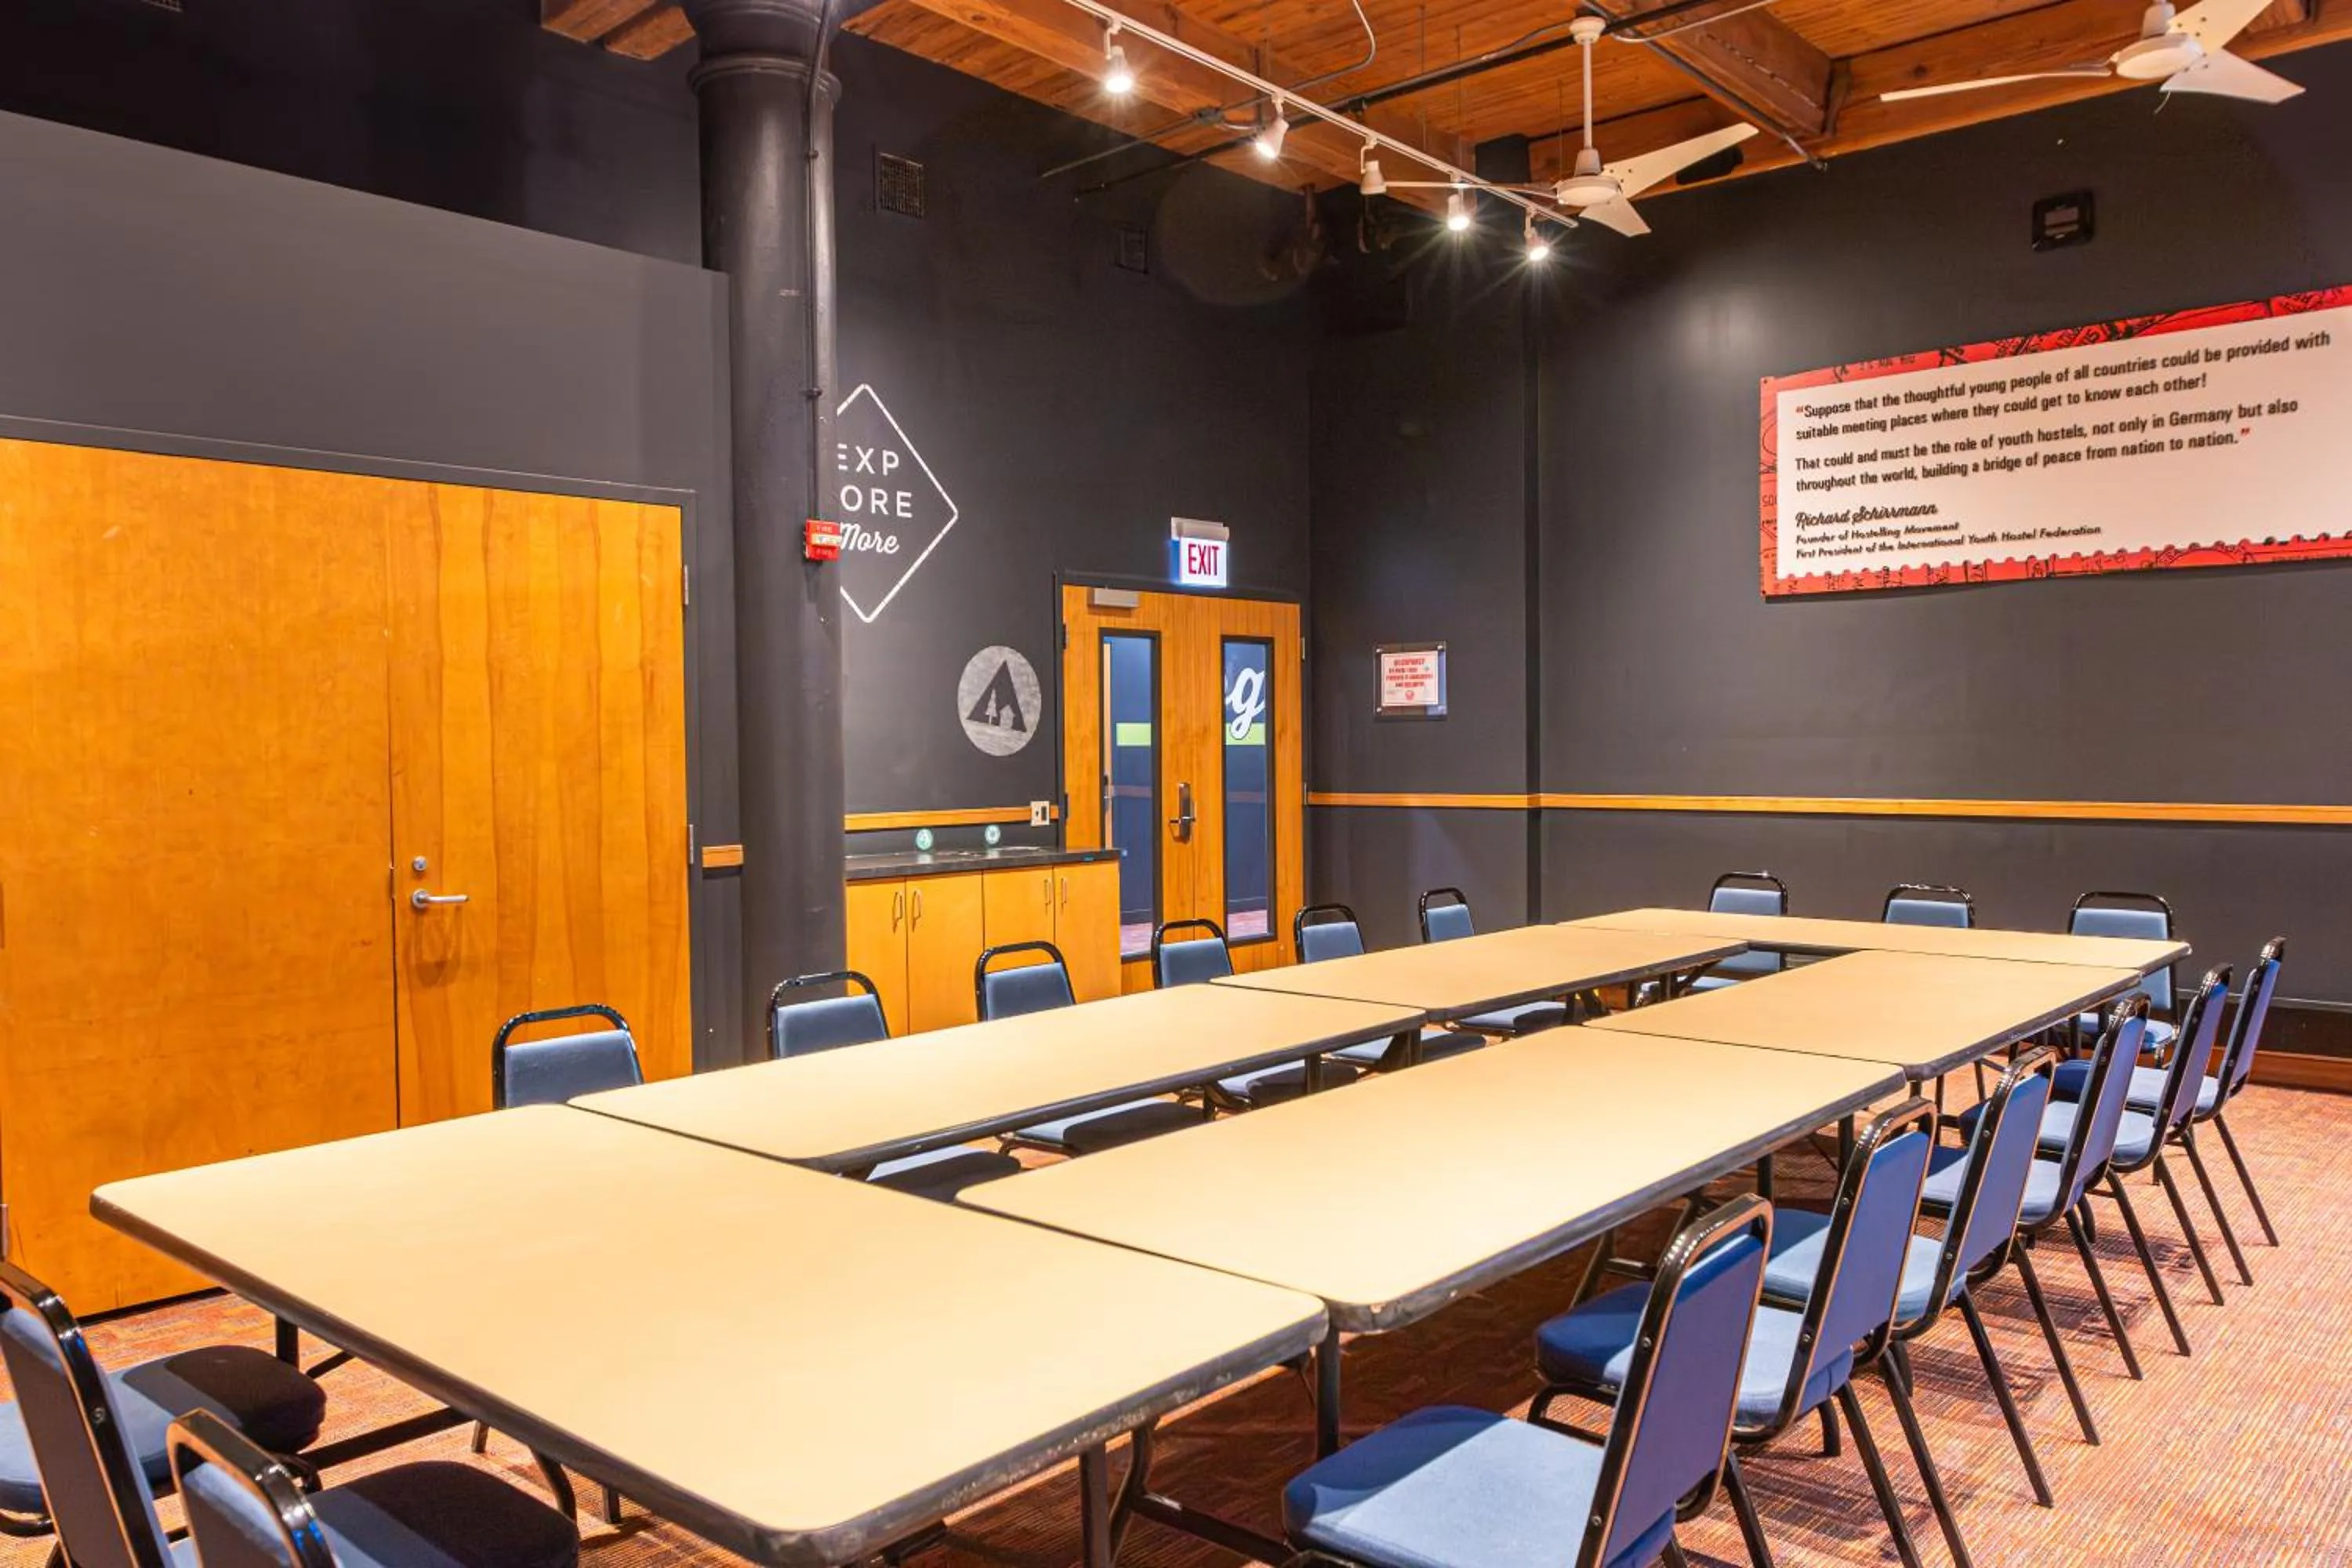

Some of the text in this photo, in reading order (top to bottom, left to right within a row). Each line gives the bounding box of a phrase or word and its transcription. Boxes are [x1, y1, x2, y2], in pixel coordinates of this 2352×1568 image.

[1855, 397, 1878, 411] that
[1882, 394, 1900, 407] the
[1904, 383, 1965, 404] thoughtful
[1969, 381, 2006, 397] young
[2010, 372, 2052, 390] people
[2056, 368, 2070, 382] of
[2074, 365, 2089, 380] all
[2093, 357, 2157, 377] countries
[2161, 349, 2199, 368] could
[2204, 347, 2221, 362] be
[2227, 336, 2290, 362] provided
[2296, 330, 2331, 350] with
[1796, 372, 2207, 440] suitable meeting places where they could get to know each other!
[1795, 398, 2298, 470] That could and must be the role of youth hostels, not only in Germany but also
[1796, 474, 1856, 492] throughout
[1860, 472, 1878, 485] the
[1882, 466, 1918, 482] world,
[1922, 463, 1969, 478] building
[1972, 461, 1980, 473] a
[1984, 455, 2021, 472] bridge
[2026, 454, 2038, 467] of
[2043, 449, 2082, 467] peace
[2086, 446, 2117, 460] from
[2121, 439, 2164, 456] nation
[2170, 437, 2183, 451] to
[840, 485, 913, 518] ORE
[1795, 504, 1938, 531] Richard Schirrmann
[1796, 522, 1960, 544] Founder of Hostelling Movement
[1796, 526, 2101, 558] First President of the International Youth Hostel Federation
[1188, 543, 1219, 576] EXIT
